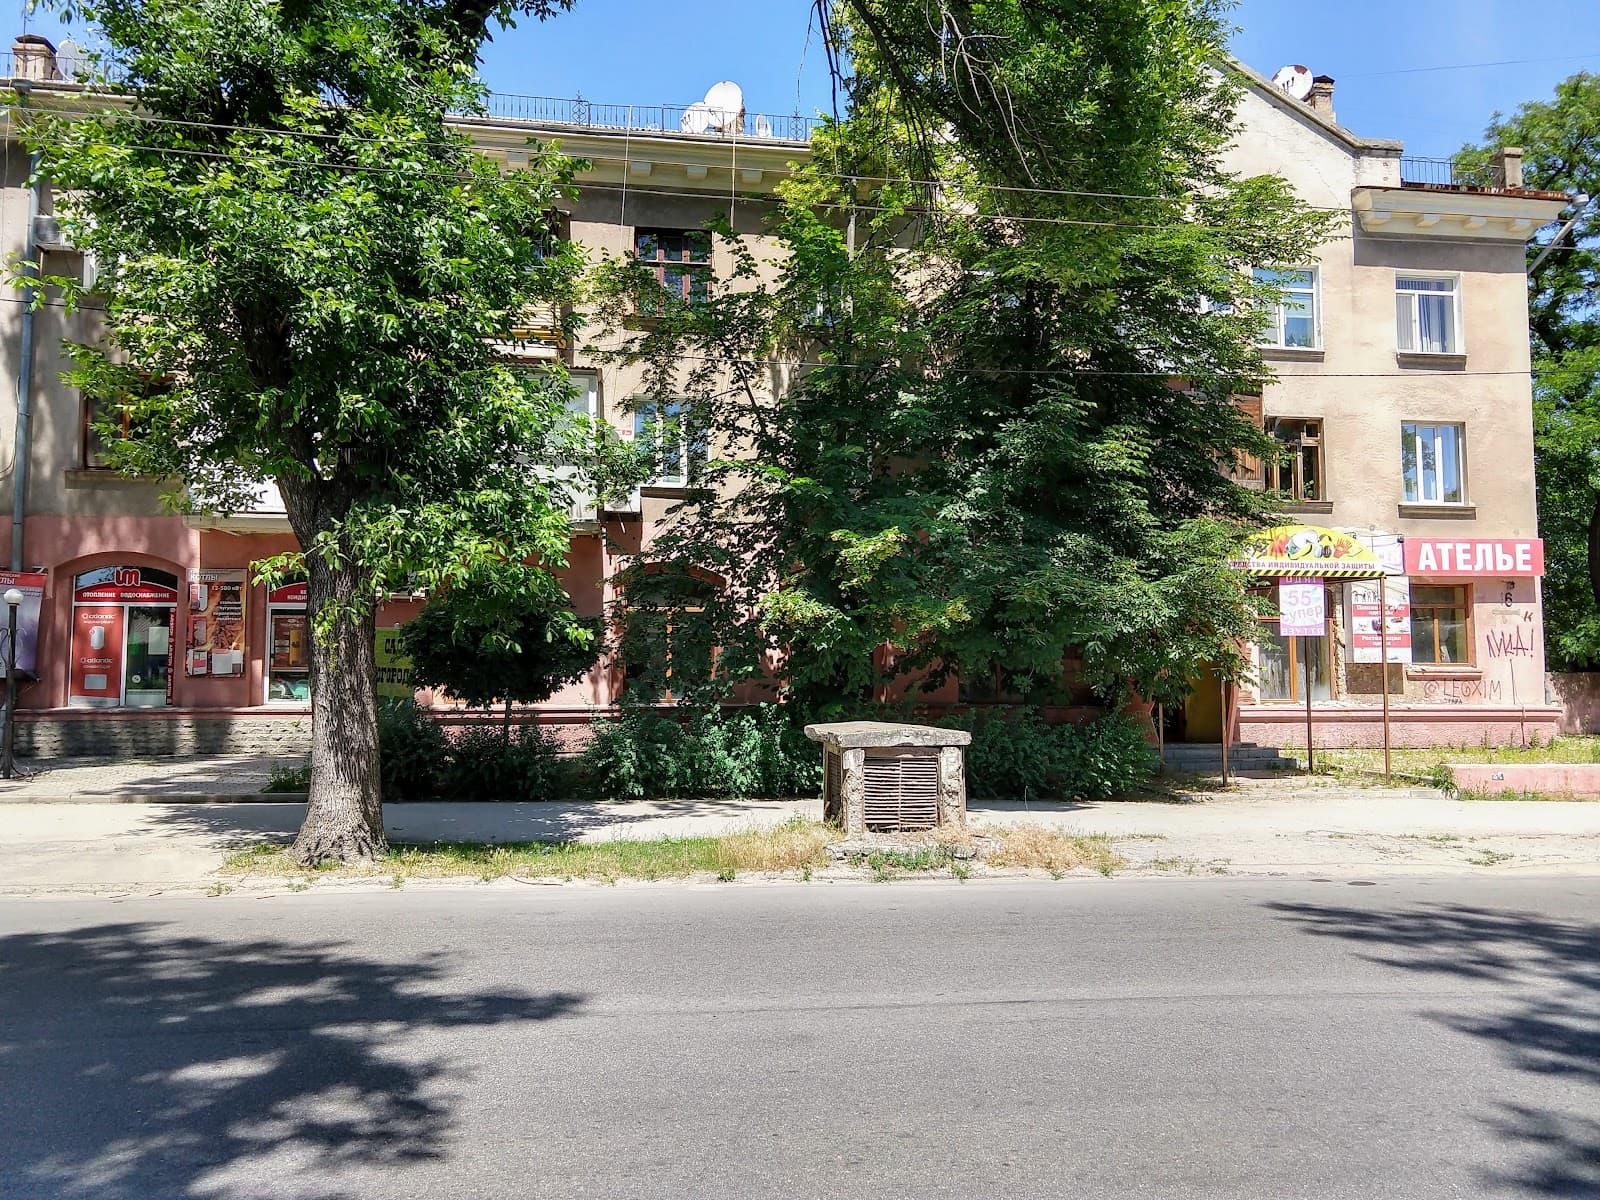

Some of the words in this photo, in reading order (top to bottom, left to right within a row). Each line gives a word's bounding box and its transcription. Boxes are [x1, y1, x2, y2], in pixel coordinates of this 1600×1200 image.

[1228, 560, 1266, 569] СРЕДСТВА
[1268, 561, 1340, 570] ИНДИВИДУАЛЬНОЙ
[1341, 562, 1375, 570] ЗАЩИТЫ
[1418, 543, 1532, 571] АТЕЛЬЕ
[1288, 590, 1312, 606] 55
